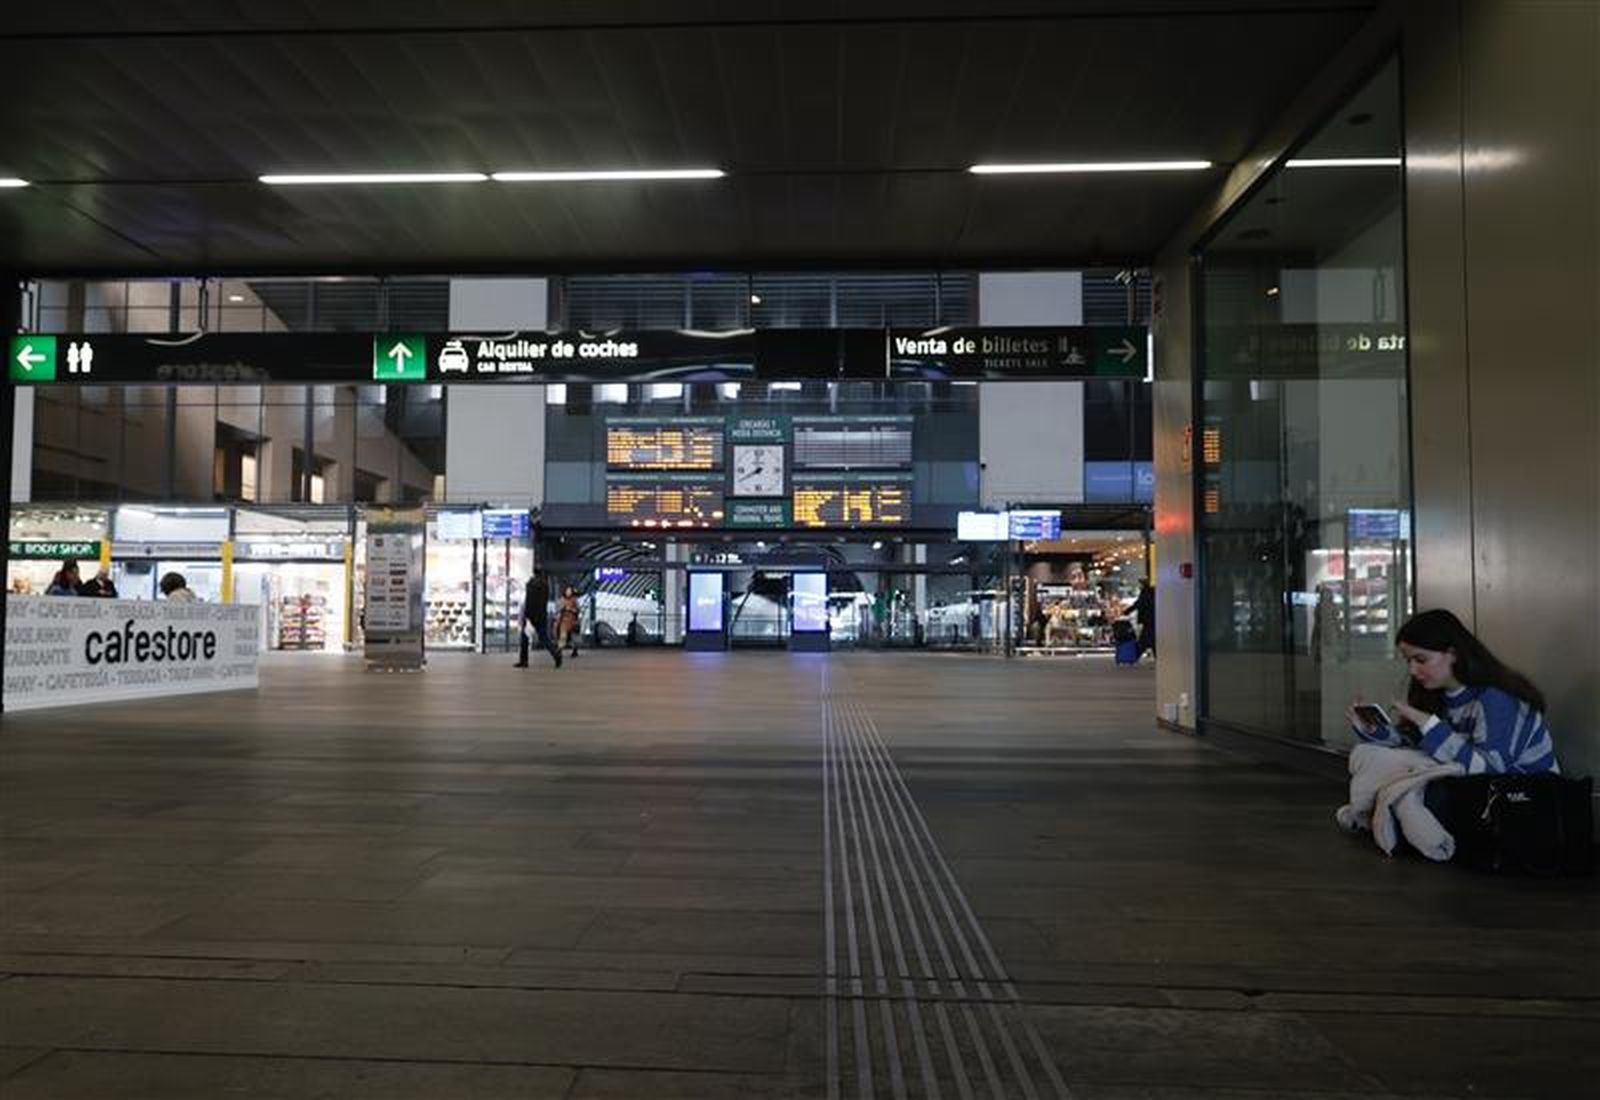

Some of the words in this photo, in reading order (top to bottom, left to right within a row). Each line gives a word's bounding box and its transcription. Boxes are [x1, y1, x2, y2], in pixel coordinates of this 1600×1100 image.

[477, 340, 547, 360] Alquiler
[551, 340, 574, 357] de
[579, 340, 638, 357] coches
[895, 336, 947, 354] Venta
[953, 337, 976, 354] de
[982, 335, 1049, 353] billetes
[25, 543, 58, 555] BODY
[85, 619, 216, 665] cafestore
